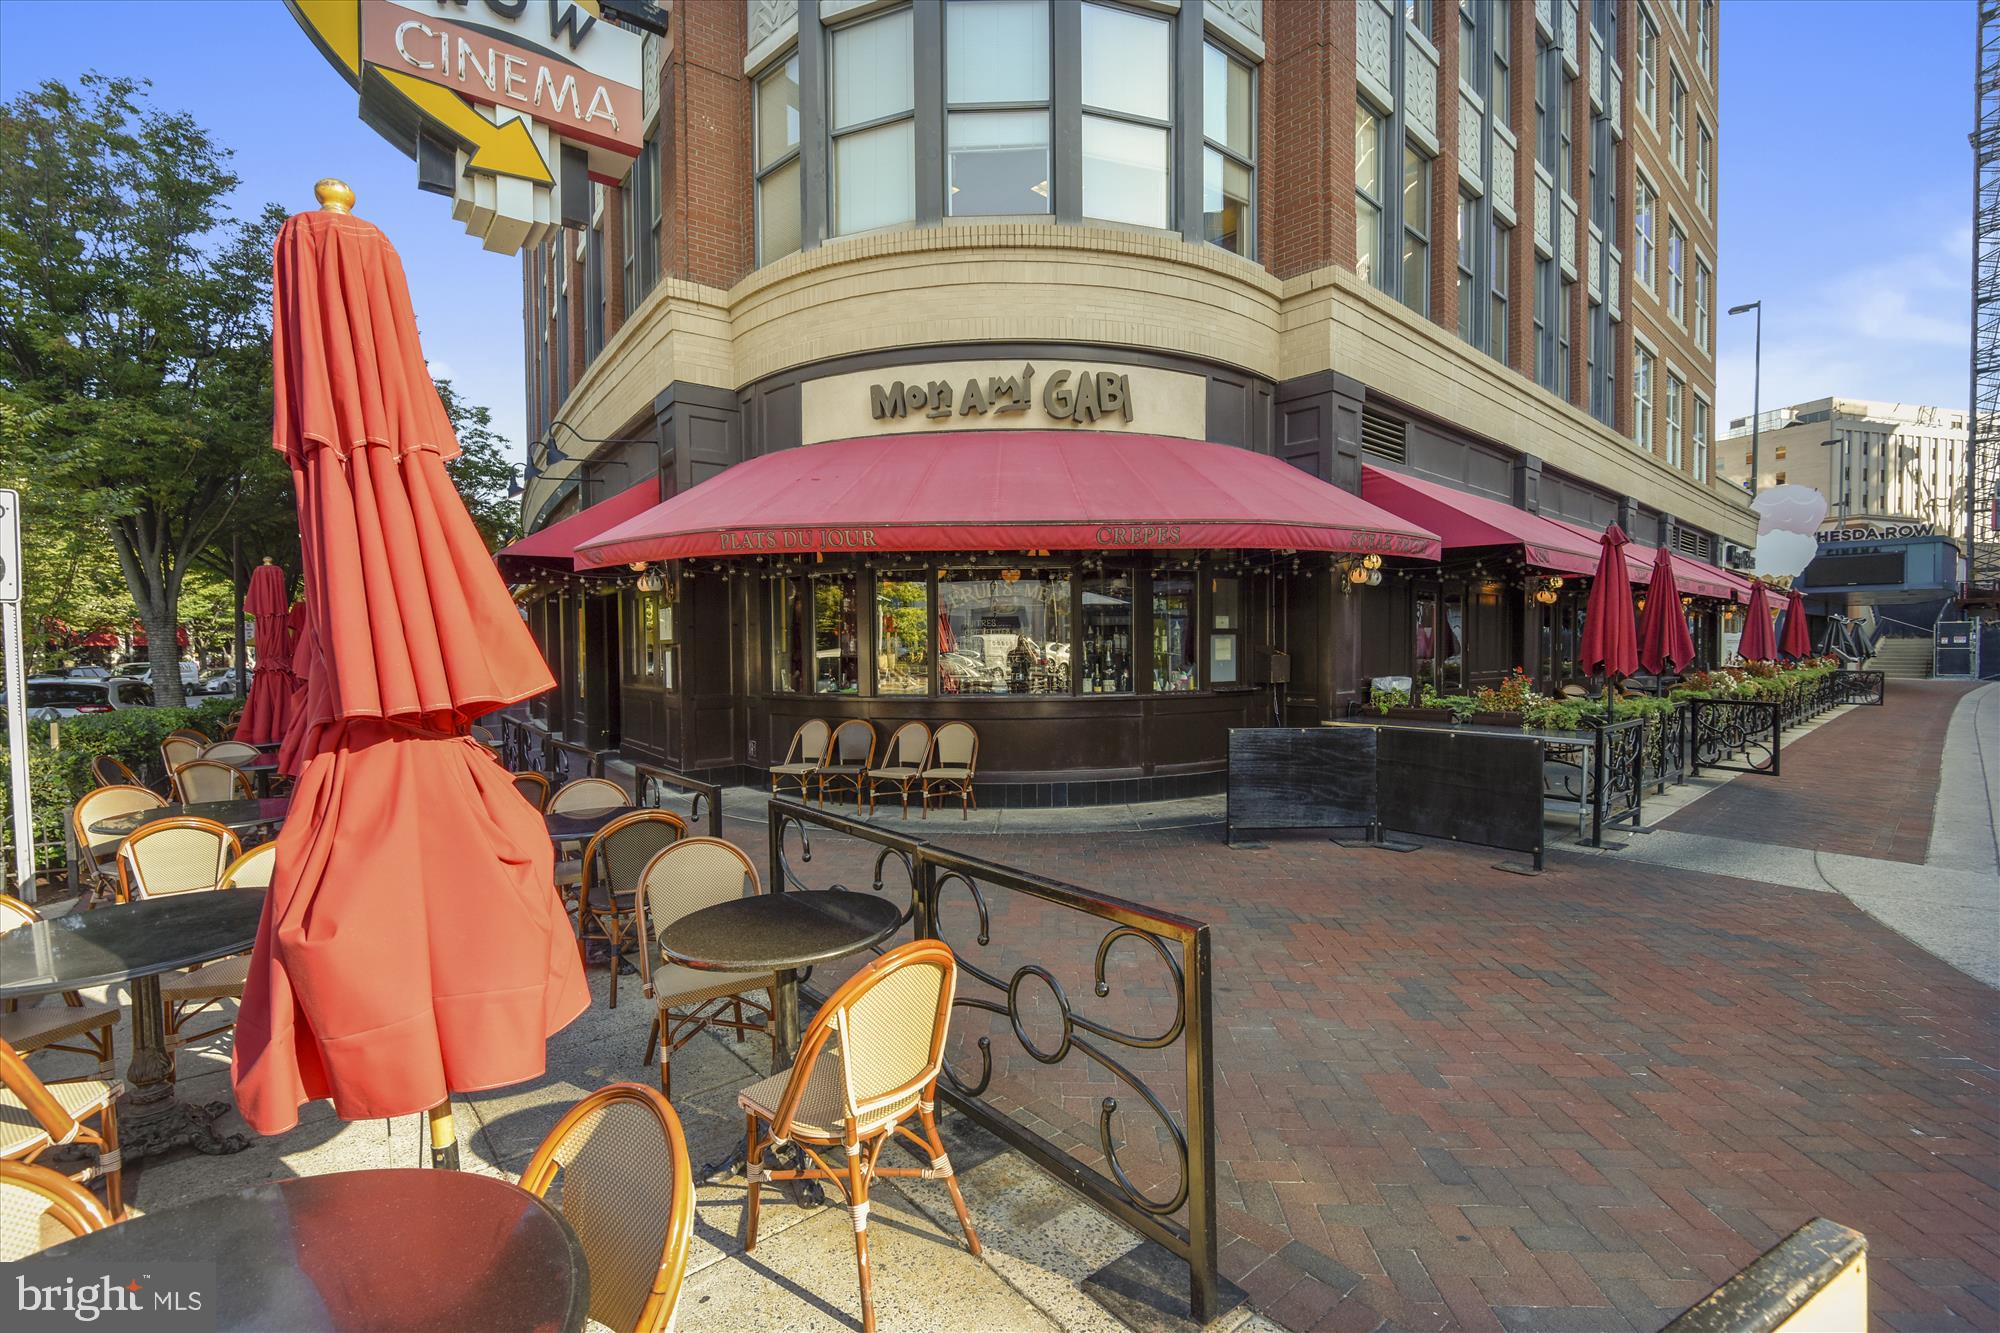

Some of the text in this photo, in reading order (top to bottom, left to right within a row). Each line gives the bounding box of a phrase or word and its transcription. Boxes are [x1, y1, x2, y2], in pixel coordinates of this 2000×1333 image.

[394, 20, 620, 132] CINEMA
[1043, 368, 1134, 424] GABI
[719, 528, 878, 551] PLATS DU JOUR
[1095, 526, 1182, 545] CREPES
[1814, 523, 1936, 543] HESDA ROW
